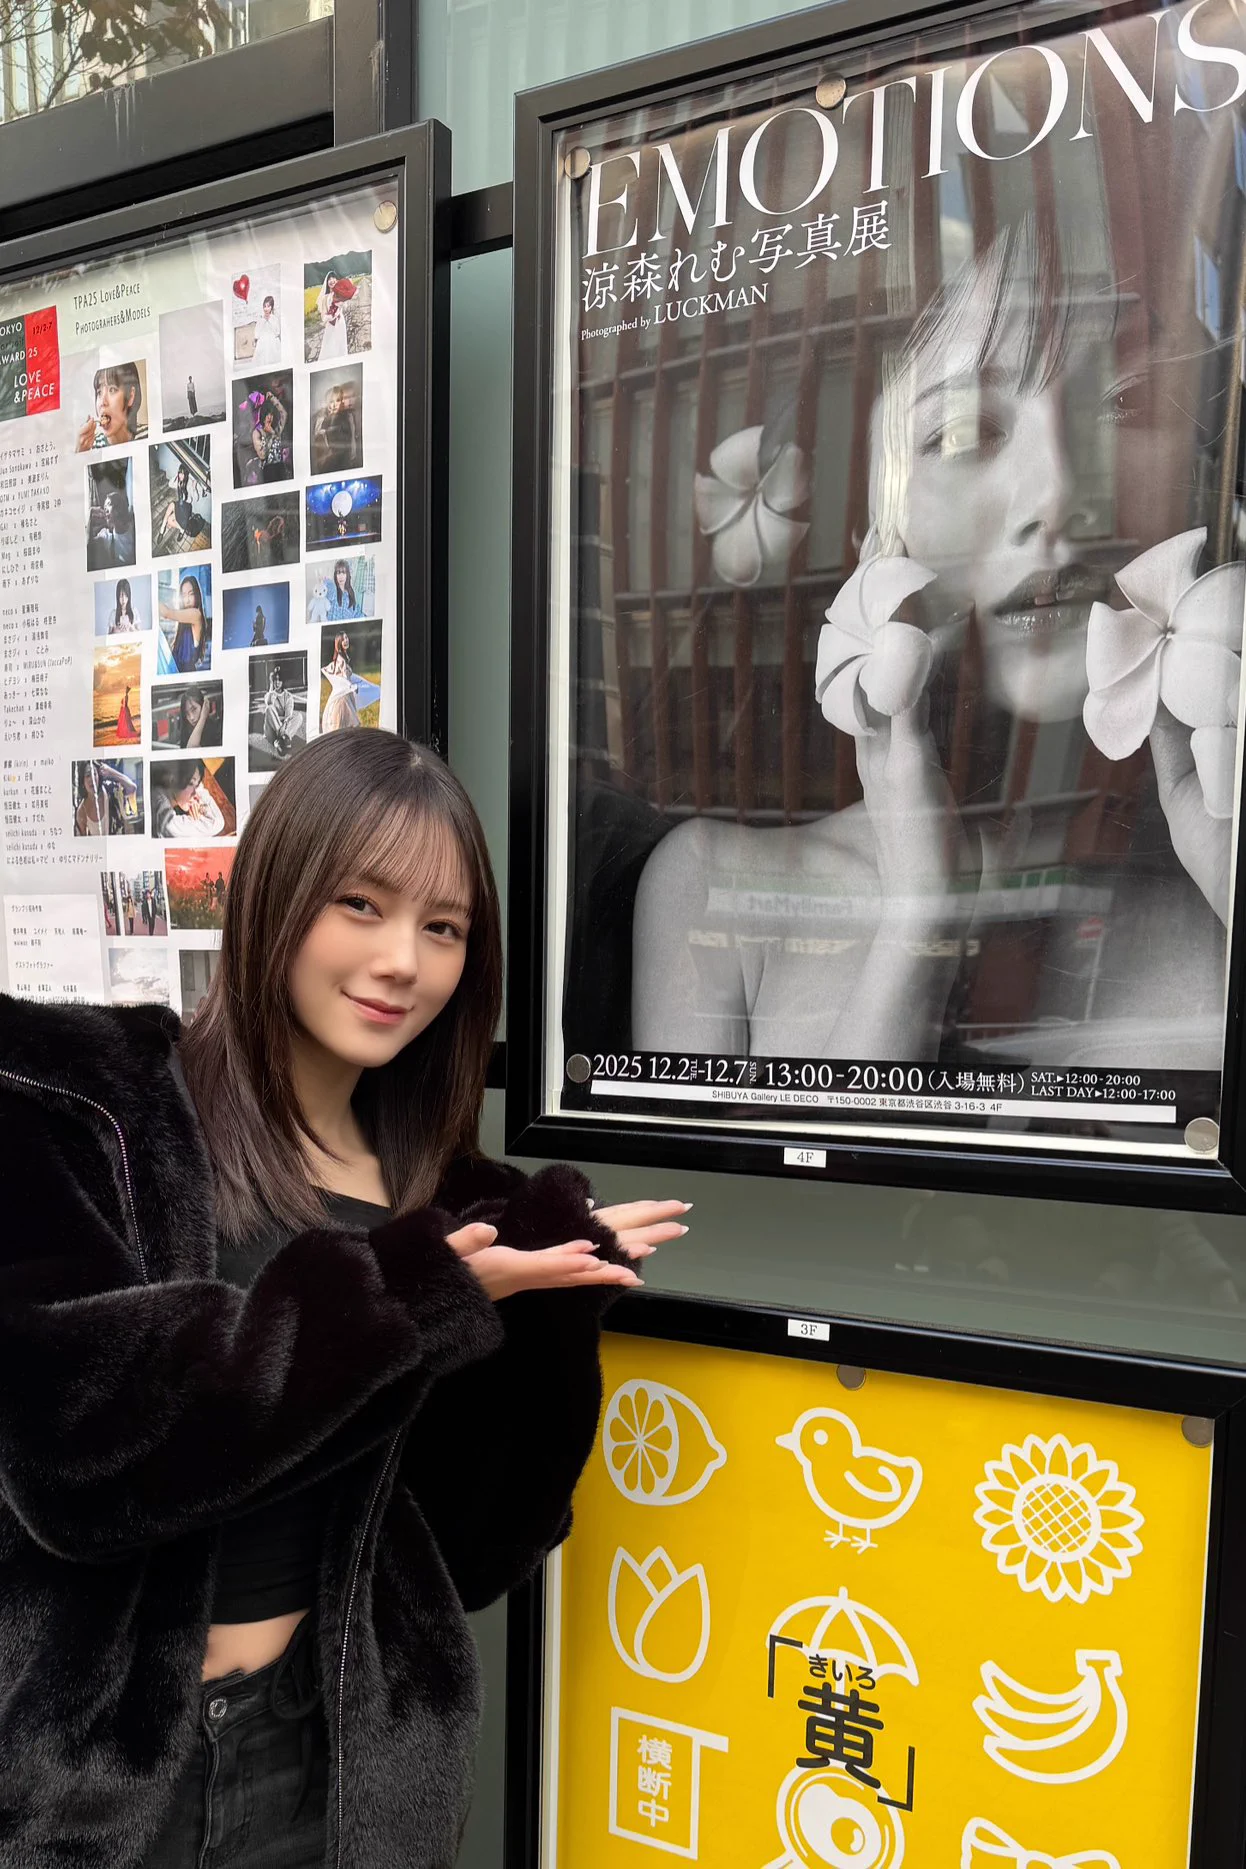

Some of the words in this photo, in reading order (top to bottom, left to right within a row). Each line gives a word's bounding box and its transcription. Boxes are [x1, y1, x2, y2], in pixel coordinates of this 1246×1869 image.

[581, 0, 1246, 258] EMOTIONS
[581, 200, 893, 313] 涼森れむ写真展
[74, 292, 98, 310] TPA25
[581, 320, 638, 340] Photographed
[640, 317, 651, 329] by
[653, 283, 768, 325] LUCKMAN
[0, 350, 26, 366] WARD
[28, 346, 38, 358] 25
[14, 370, 41, 388] LOVE
[14, 382, 54, 404] &PEACE
[593, 1054, 642, 1078] 2025
[649, 1056, 690, 1081] 12.2
[1030, 1072, 1057, 1084] SAT.
[1065, 1073, 1141, 1087] 12:00-20:00
[712, 1090, 749, 1101] SHIBUYA
[750, 1092, 778, 1104] Gallery
[779, 1092, 791, 1102] LE
[793, 1092, 820, 1103] DECO
[879, 1097, 952, 1110] 東京都渋谷区渋谷
[990, 1103, 1002, 1112] 4F
[1031, 1086, 1064, 1096] LAST
[1066, 1087, 1095, 1098] DAY
[1102, 1088, 1176, 1101] 12:00-17:00
[796, 1151, 814, 1164] 4F
[800, 1324, 818, 1336] 3F
[808, 1653, 876, 1690] きいろ
[637, 1735, 673, 1828] 横断中
